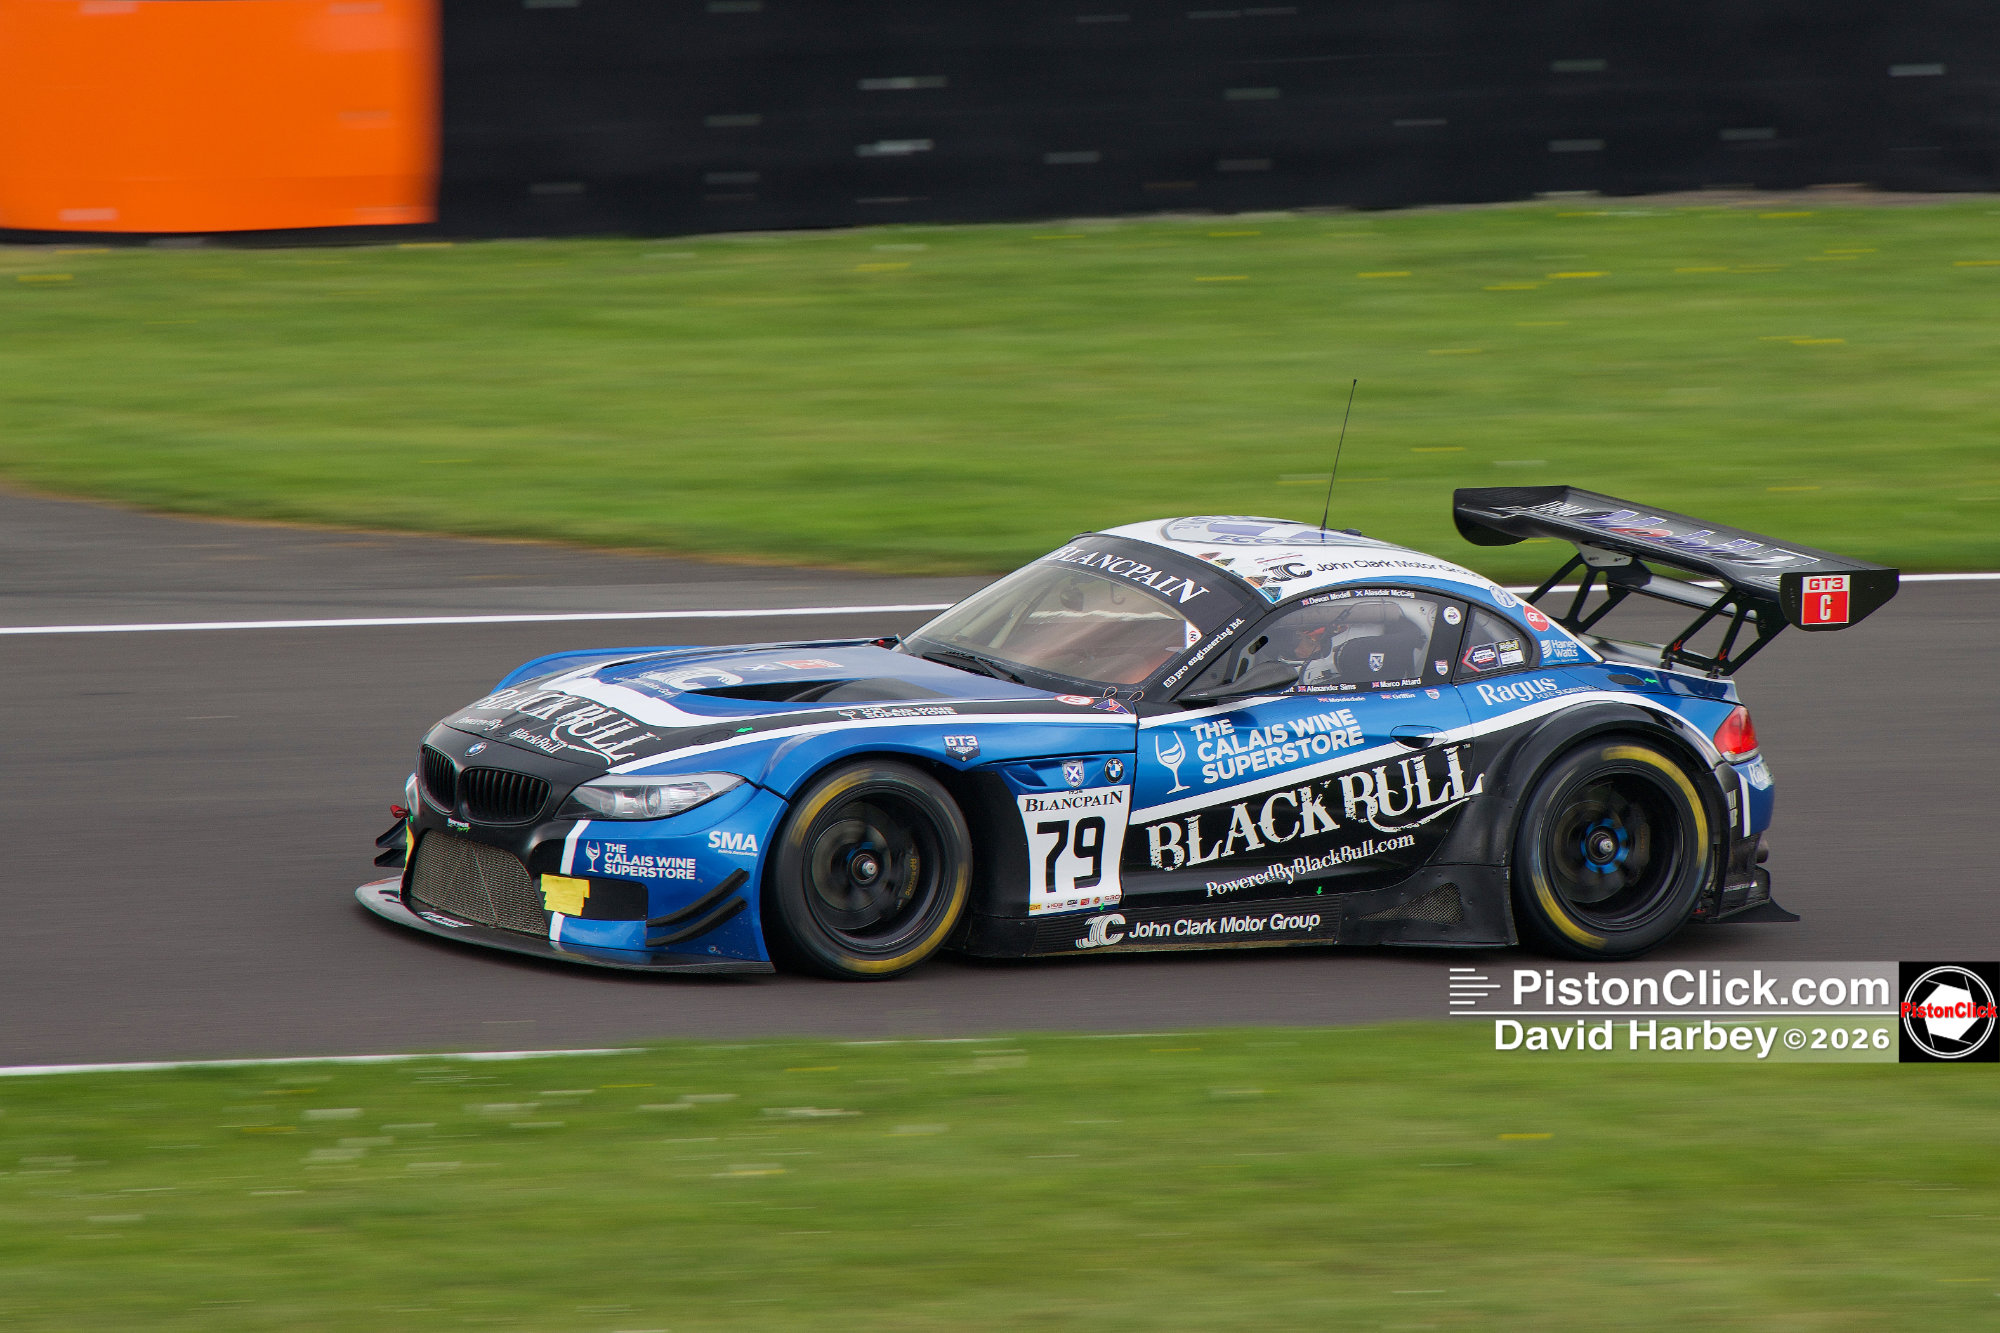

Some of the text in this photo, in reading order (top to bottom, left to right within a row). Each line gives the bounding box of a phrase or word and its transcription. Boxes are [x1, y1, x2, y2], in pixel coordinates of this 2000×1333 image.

[1044, 546, 1210, 604] BLANCPAIN
[1316, 561, 1354, 572] John
[1354, 559, 1394, 569] Clark
[1808, 577, 1844, 591] GT3
[1820, 594, 1832, 621] C
[1174, 664, 1189, 680] pro
[1188, 627, 1234, 667] engineering
[1551, 639, 1578, 649] Haines
[1553, 648, 1579, 658] Watts
[1306, 684, 1339, 693] Alexander
[1339, 683, 1357, 691] Sims
[1379, 678, 1422, 689] Marco Attard
[1475, 677, 1558, 706] Ragus
[468, 689, 578, 721] BLACK
[550, 698, 657, 766] BULL
[943, 735, 978, 747] GT3
[1191, 718, 1235, 743] THE
[1197, 708, 1358, 763] CALAIS WINE
[1202, 724, 1366, 785] SUPERSTORE
[1024, 790, 1124, 812] BLANCPAIN
[1145, 746, 1485, 872] BLACK BULL
[604, 843, 627, 854] THE
[707, 831, 759, 852] SMA
[604, 853, 696, 869] CALAIS WINE
[1036, 815, 1106, 894] 79
[1206, 834, 1416, 897] PoweredByBlackBull.com
[604, 863, 696, 880] SUPERSTORE
[1128, 920, 1171, 939] John
[1174, 918, 1216, 937] Clark
[1219, 915, 1267, 934] Motor
[1270, 913, 1321, 932] Group
